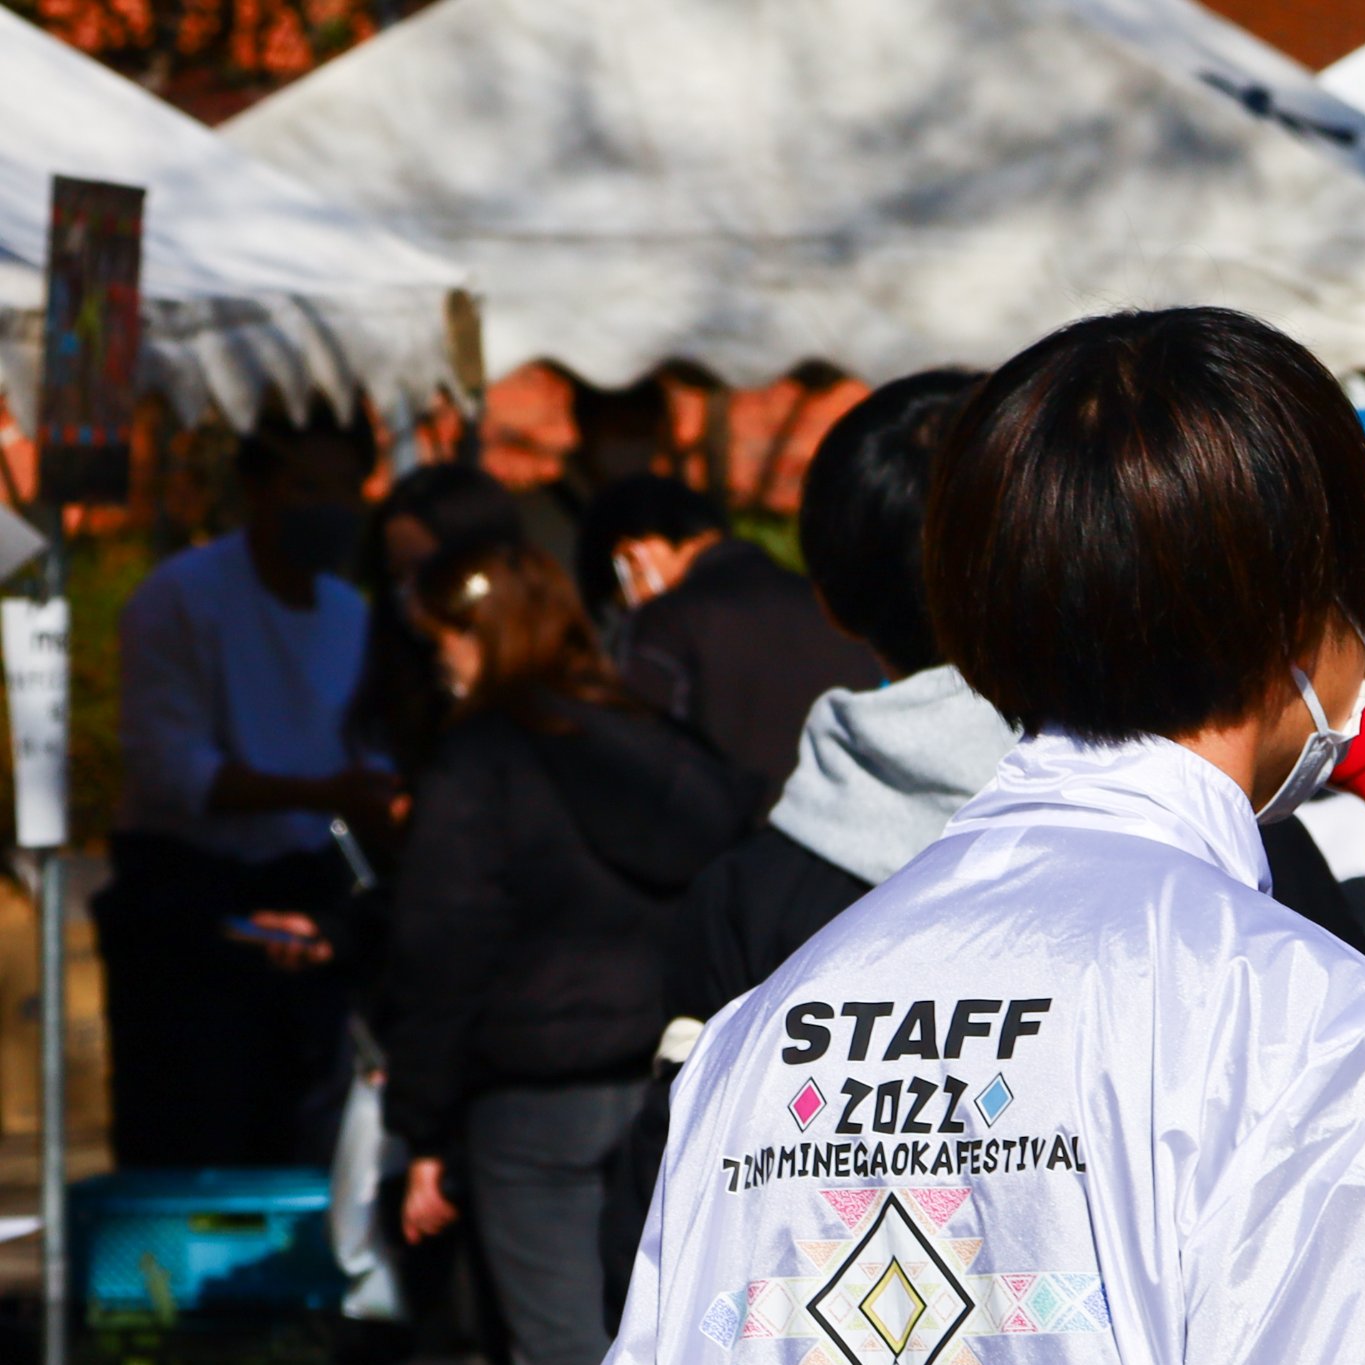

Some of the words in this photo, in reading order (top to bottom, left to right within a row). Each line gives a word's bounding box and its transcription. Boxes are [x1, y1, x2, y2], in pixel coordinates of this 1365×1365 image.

[781, 998, 1053, 1065] STAFF
[834, 1075, 969, 1135] 2022
[722, 1145, 776, 1194] 72ND
[776, 1134, 1087, 1179] MINEGAOKAFESTIVAL
